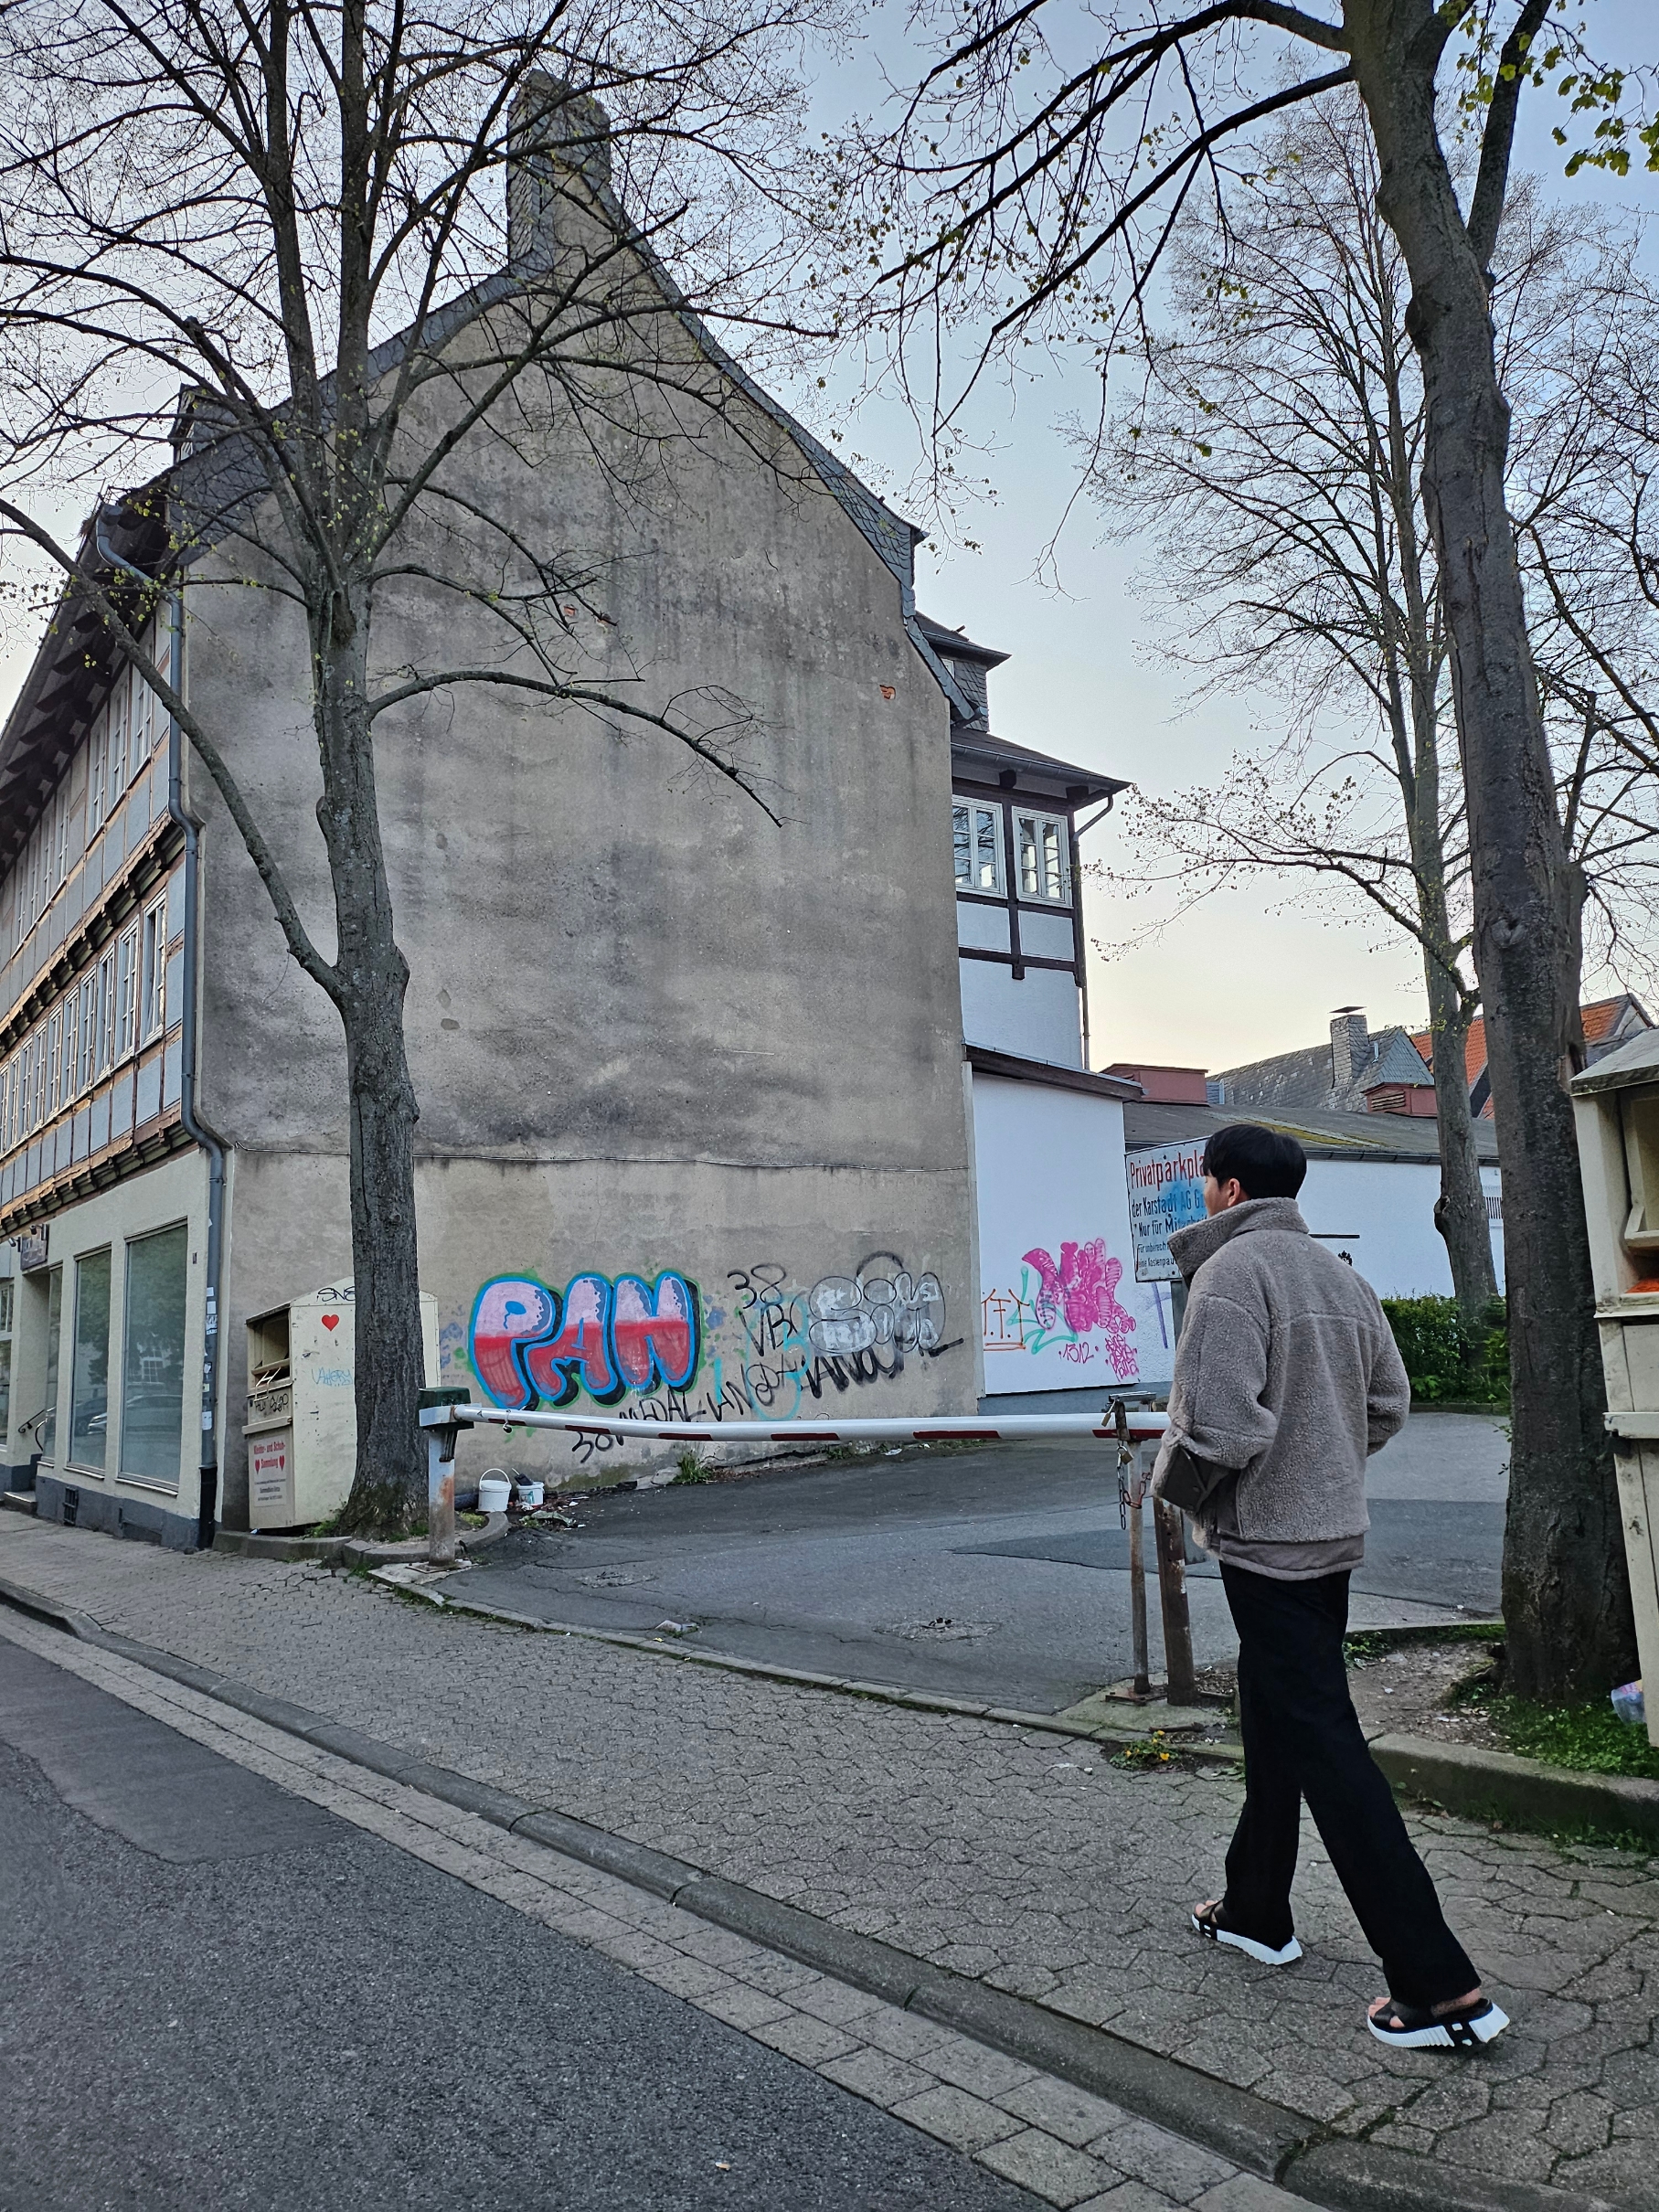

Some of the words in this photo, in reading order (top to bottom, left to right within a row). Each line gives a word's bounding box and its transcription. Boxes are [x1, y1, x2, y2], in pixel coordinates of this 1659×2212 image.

[1130, 1150, 1205, 1191] Privatparkpla
[1132, 1199, 1142, 1218] der
[1143, 1193, 1177, 1217] Karstadt
[1181, 1190, 1192, 1211] AG
[1139, 1223, 1151, 1237] Nur
[1152, 1220, 1163, 1235] für
